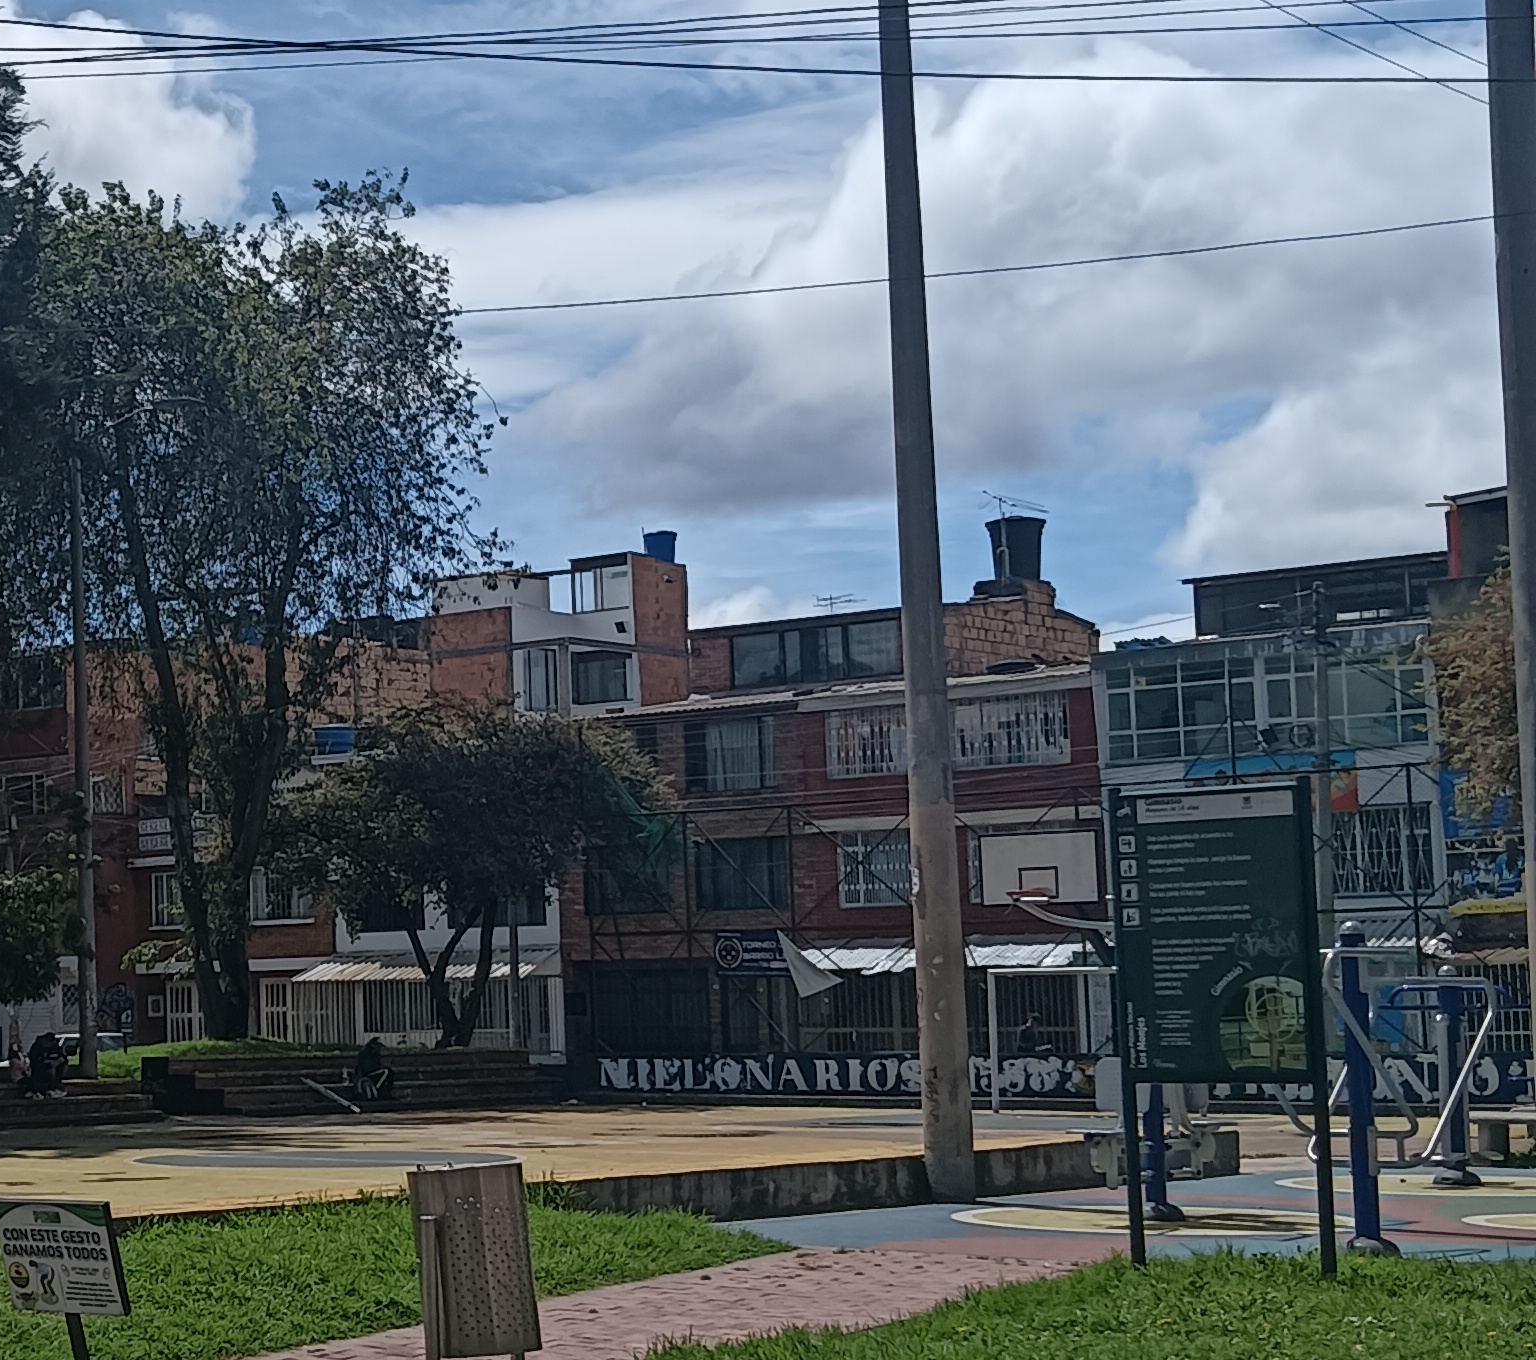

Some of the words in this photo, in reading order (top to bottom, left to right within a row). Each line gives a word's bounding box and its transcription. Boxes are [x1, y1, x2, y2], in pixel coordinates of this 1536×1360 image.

[1210, 965, 1244, 997] Gimnasio
[1135, 1016, 1148, 1051] Monjes
[1136, 1052, 1148, 1069] Los
[3, 1228, 29, 1242] CON
[30, 1228, 60, 1243] ESTE
[61, 1230, 101, 1246] GESTO
[3, 1244, 64, 1259] GANAMOS
[66, 1246, 108, 1261] TODOS
